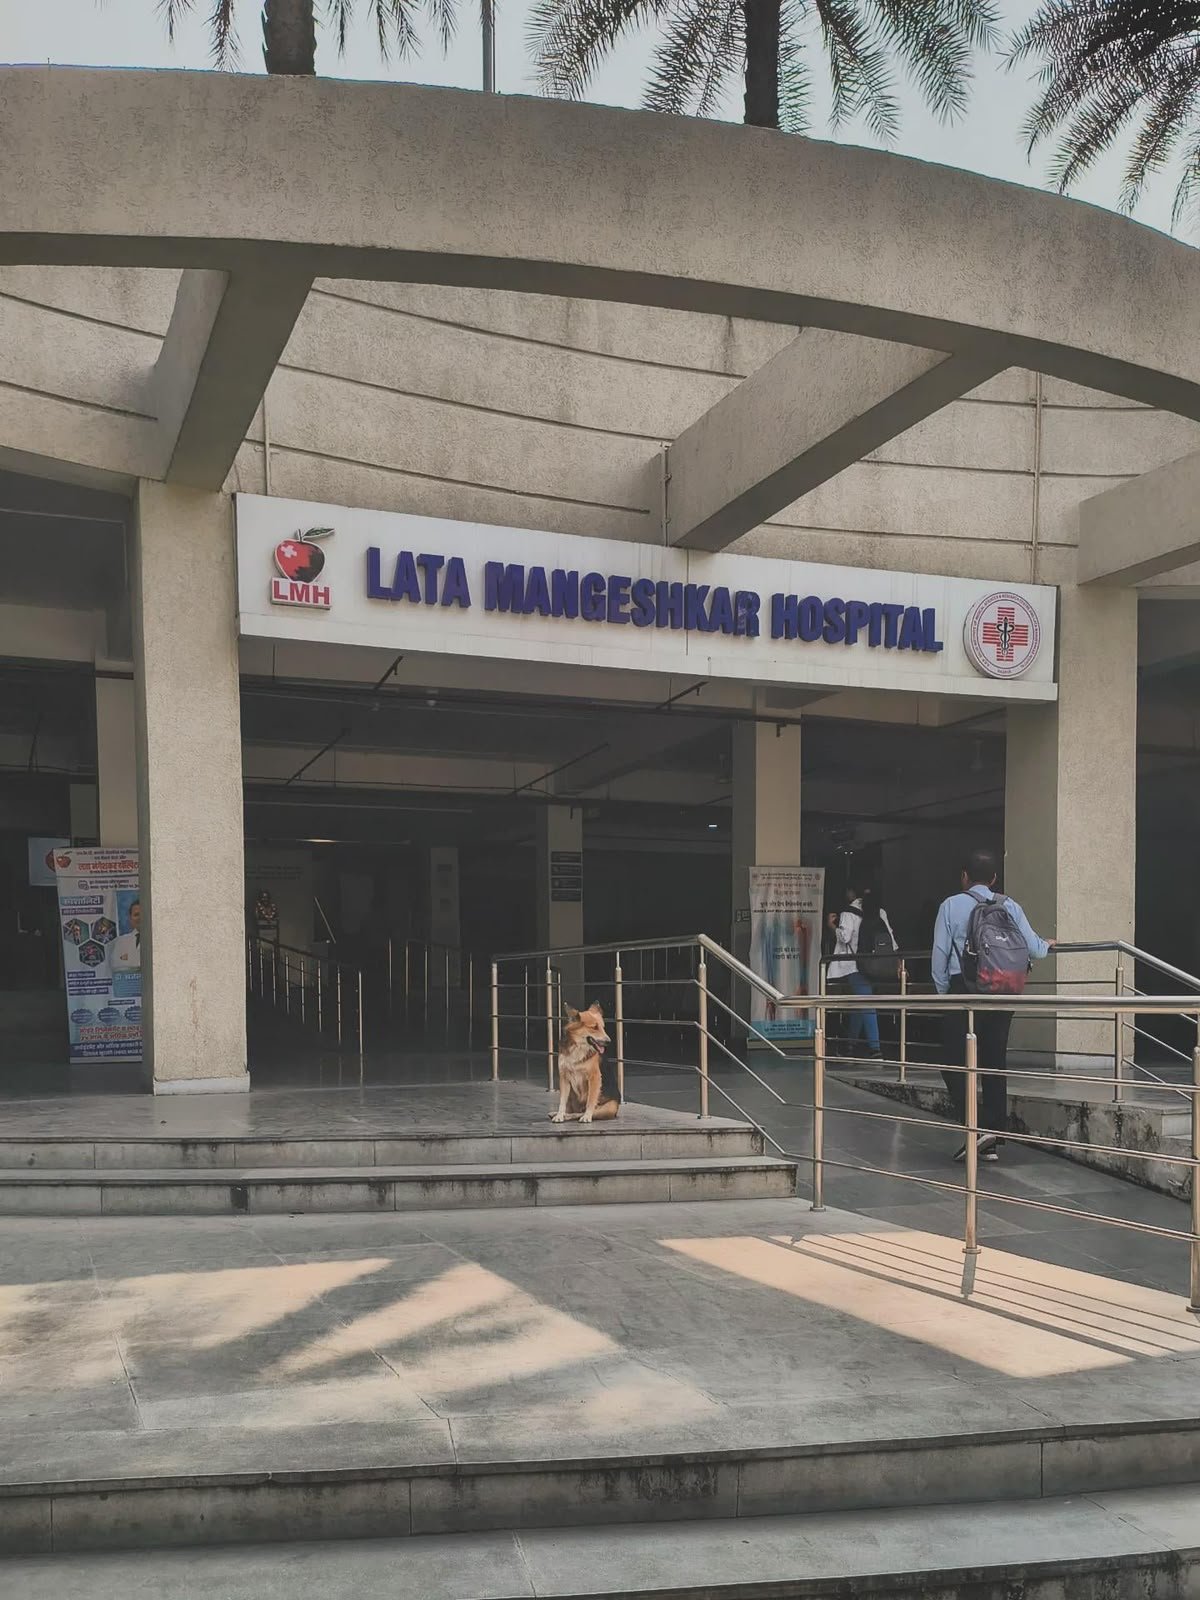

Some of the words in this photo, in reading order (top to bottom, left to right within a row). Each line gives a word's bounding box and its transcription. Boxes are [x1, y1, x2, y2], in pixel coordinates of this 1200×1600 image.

[273, 579, 331, 606] LMH
[367, 546, 472, 608] LATA
[484, 561, 761, 638] MANGESHKAR
[771, 593, 944, 653] HOSPITAL
